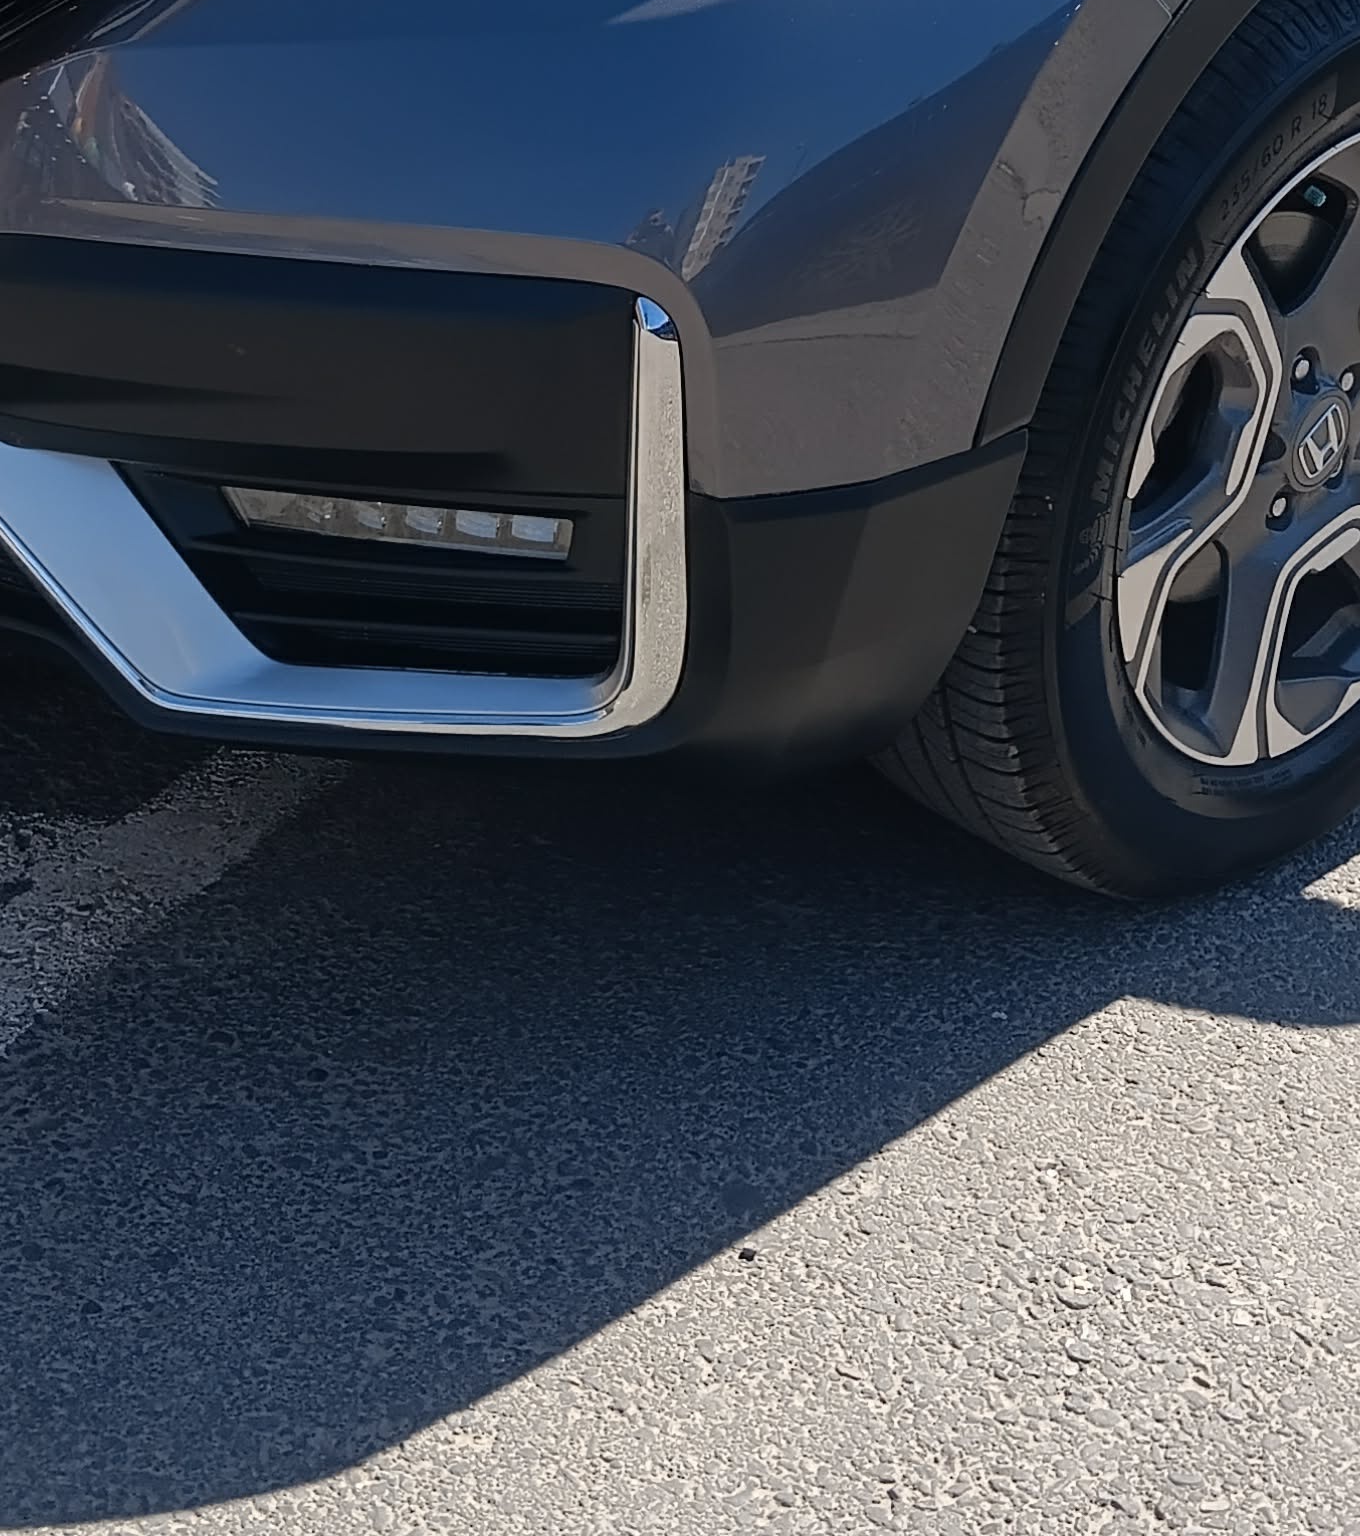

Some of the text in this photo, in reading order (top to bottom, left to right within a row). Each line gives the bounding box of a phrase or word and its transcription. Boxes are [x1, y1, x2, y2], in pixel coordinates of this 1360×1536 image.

[1220, 93, 1328, 221] 235/60 R 18
[1090, 245, 1202, 505] MICHELIN
